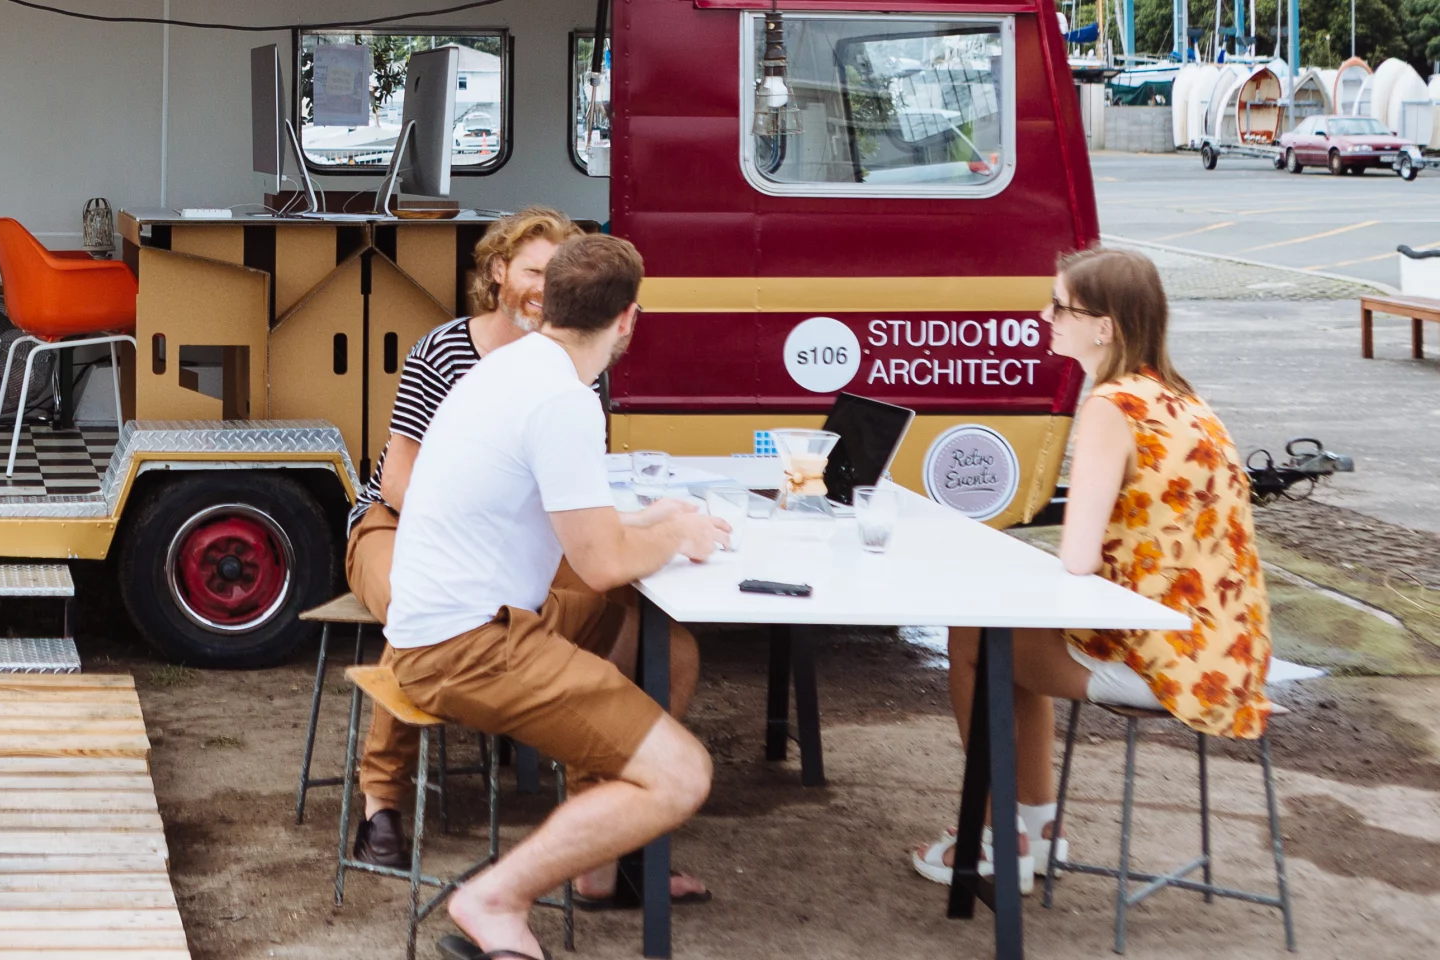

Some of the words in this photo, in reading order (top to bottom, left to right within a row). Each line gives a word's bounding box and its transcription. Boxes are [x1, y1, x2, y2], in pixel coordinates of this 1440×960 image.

[867, 318, 1040, 347] STUDIO106
[796, 345, 848, 366] s106
[867, 358, 1041, 386] ARCHITECT
[949, 448, 995, 469] Retro
[945, 467, 999, 489] Events
